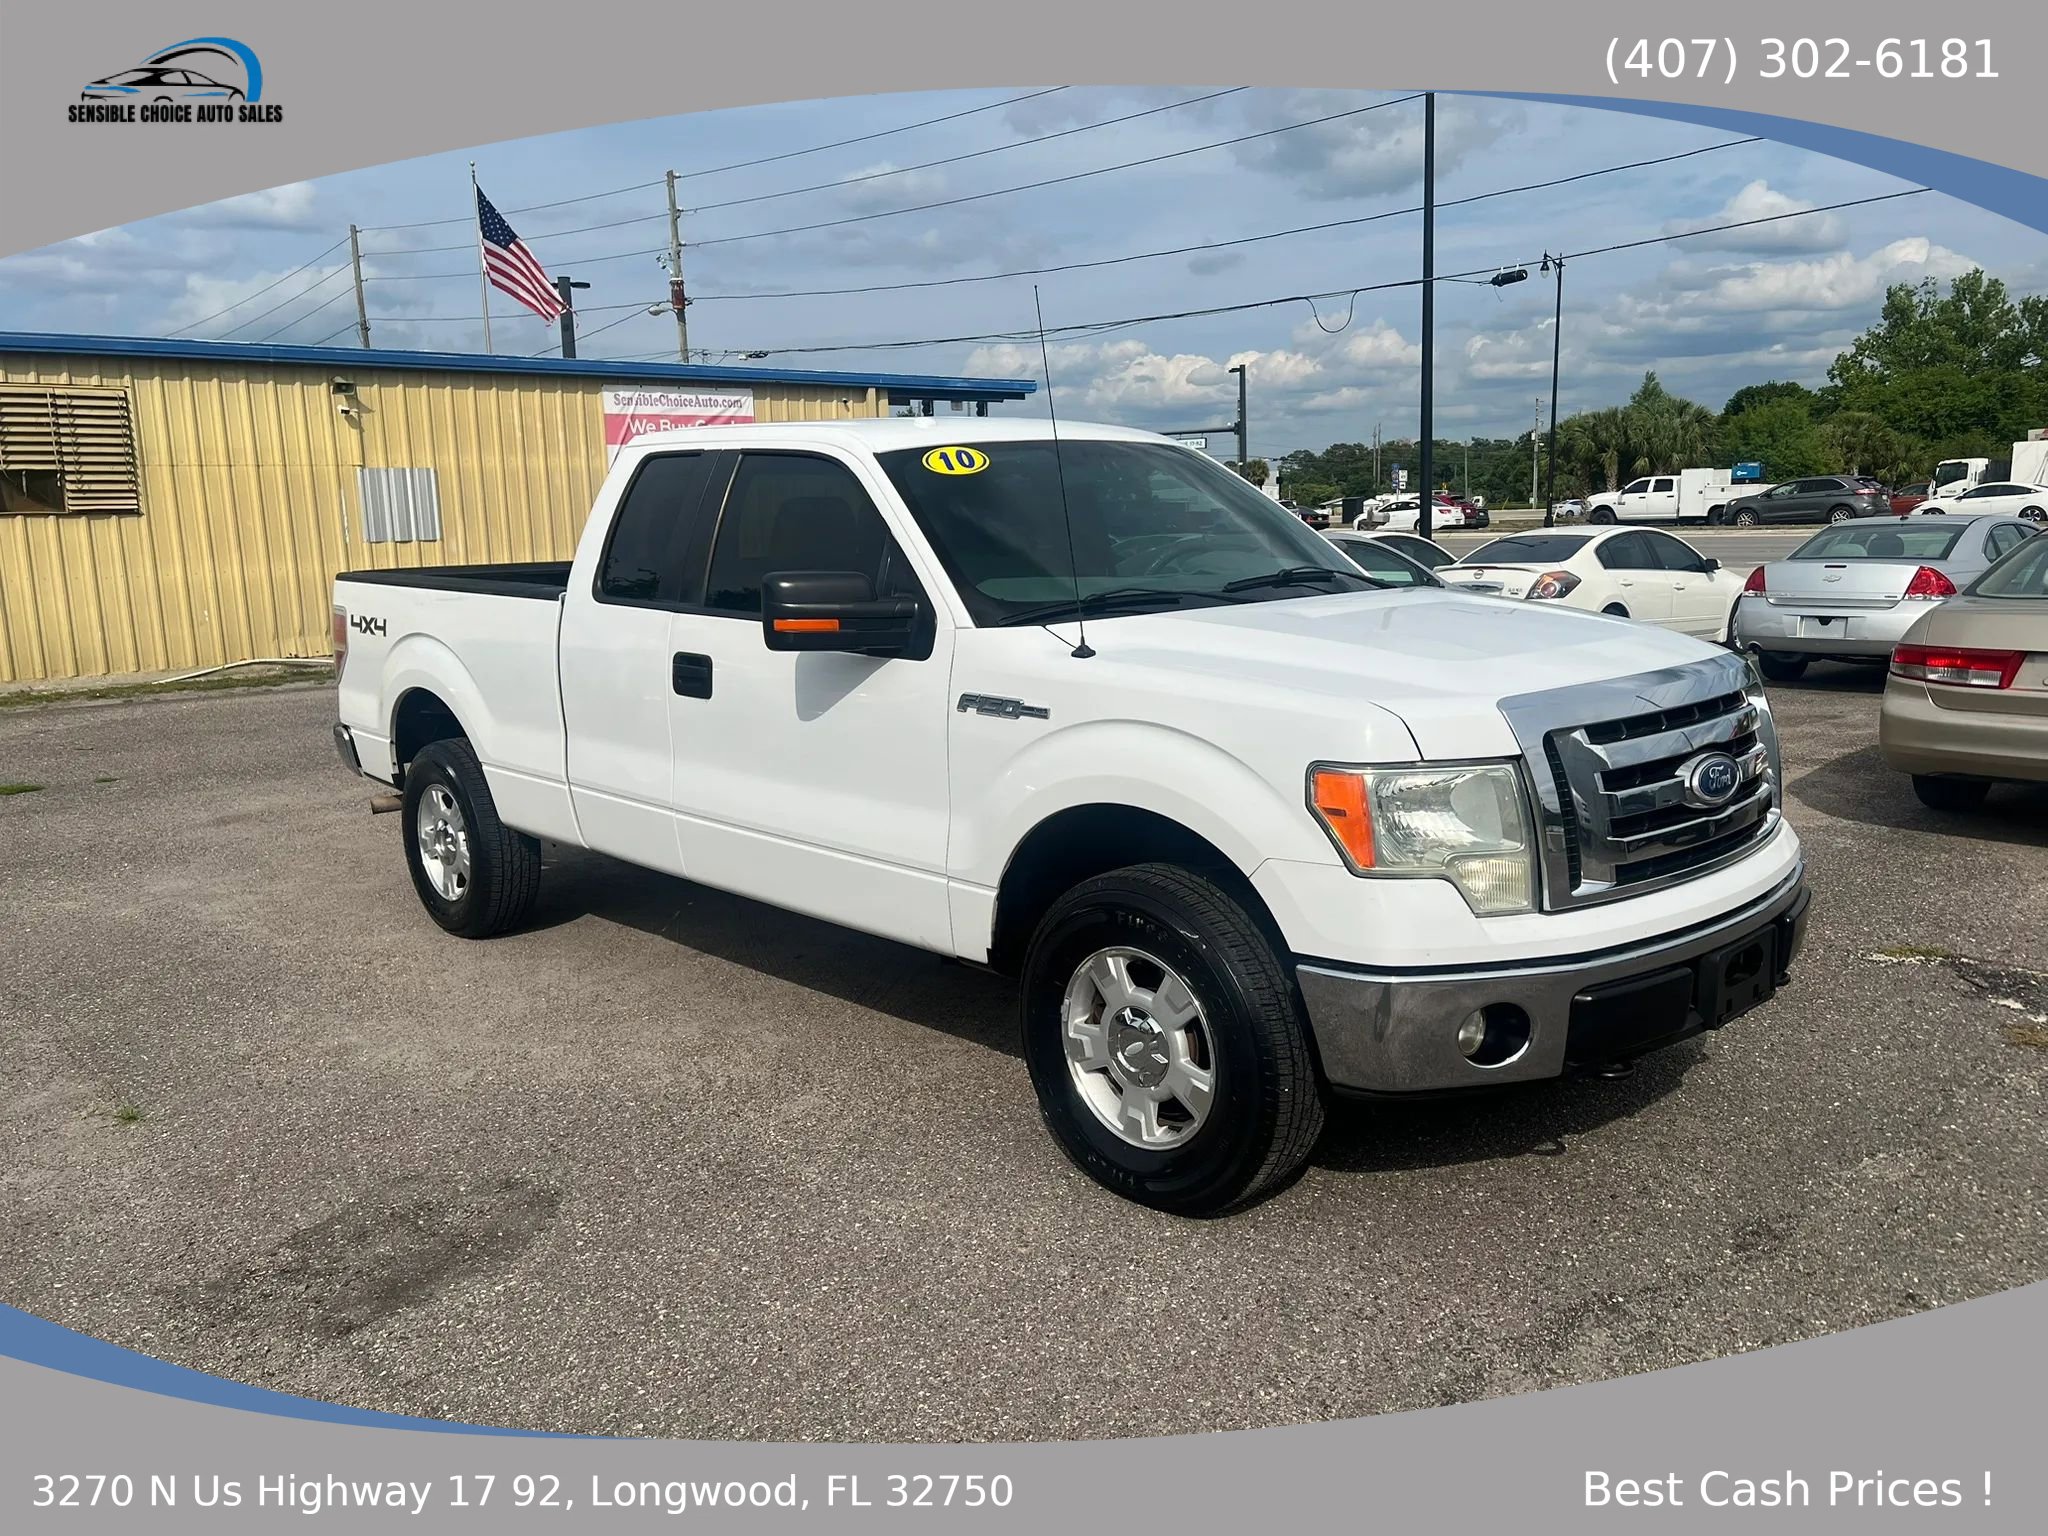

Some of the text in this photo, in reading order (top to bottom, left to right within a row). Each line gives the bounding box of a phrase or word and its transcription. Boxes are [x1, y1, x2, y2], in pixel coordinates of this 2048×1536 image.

[629, 419, 656, 434] We
[939, 449, 975, 471] 10
[1708, 765, 1732, 790] Ford
